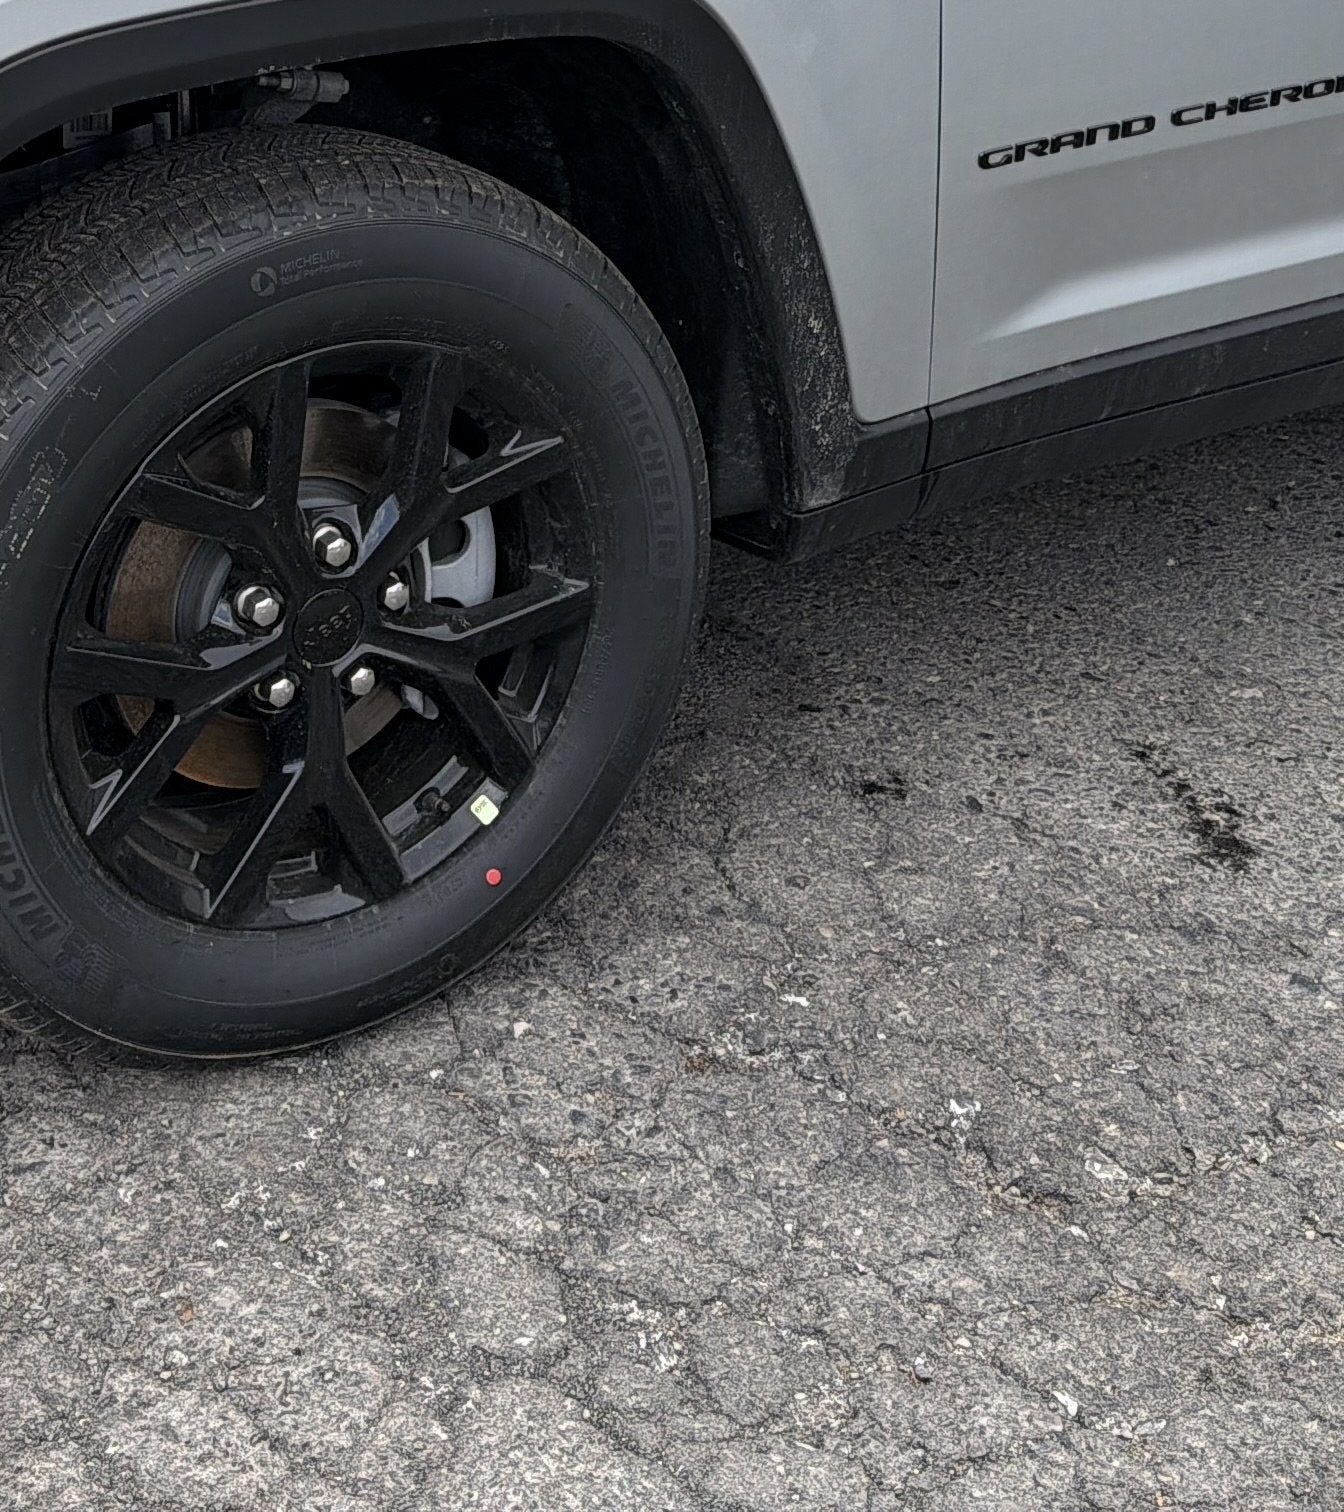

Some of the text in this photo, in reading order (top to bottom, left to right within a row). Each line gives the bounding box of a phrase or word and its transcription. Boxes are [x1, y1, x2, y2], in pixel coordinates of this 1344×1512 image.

[977, 114, 1156, 170] GRAND
[280, 248, 340, 274] MICHELIN
[610, 377, 678, 567] MICHELIN
